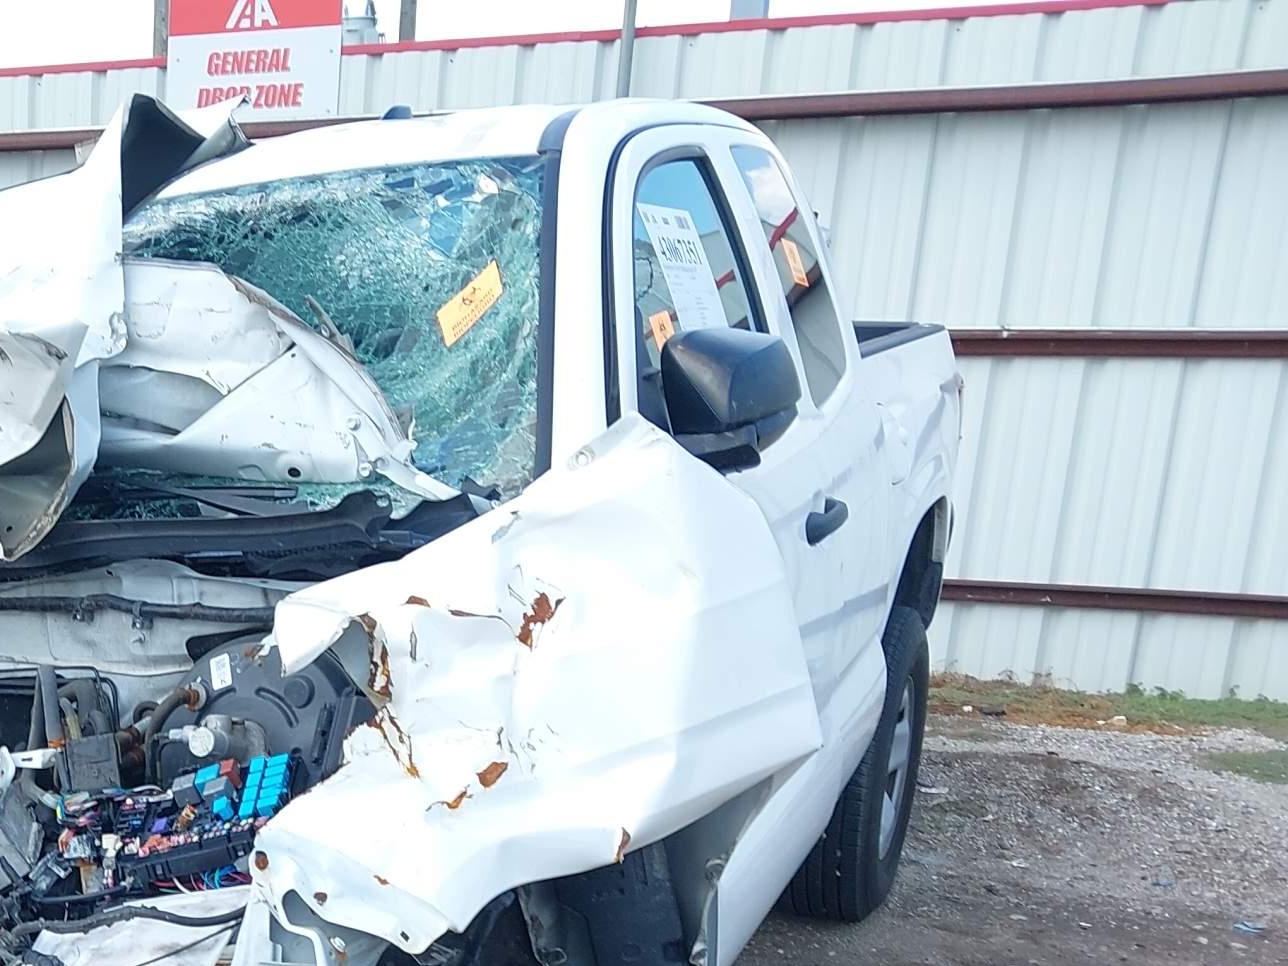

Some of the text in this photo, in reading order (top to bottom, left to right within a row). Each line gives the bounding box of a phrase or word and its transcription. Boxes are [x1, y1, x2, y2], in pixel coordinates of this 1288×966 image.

[206, 48, 291, 76] GENERAL
[253, 82, 305, 109] ZONE
[657, 234, 703, 265] 43067351
